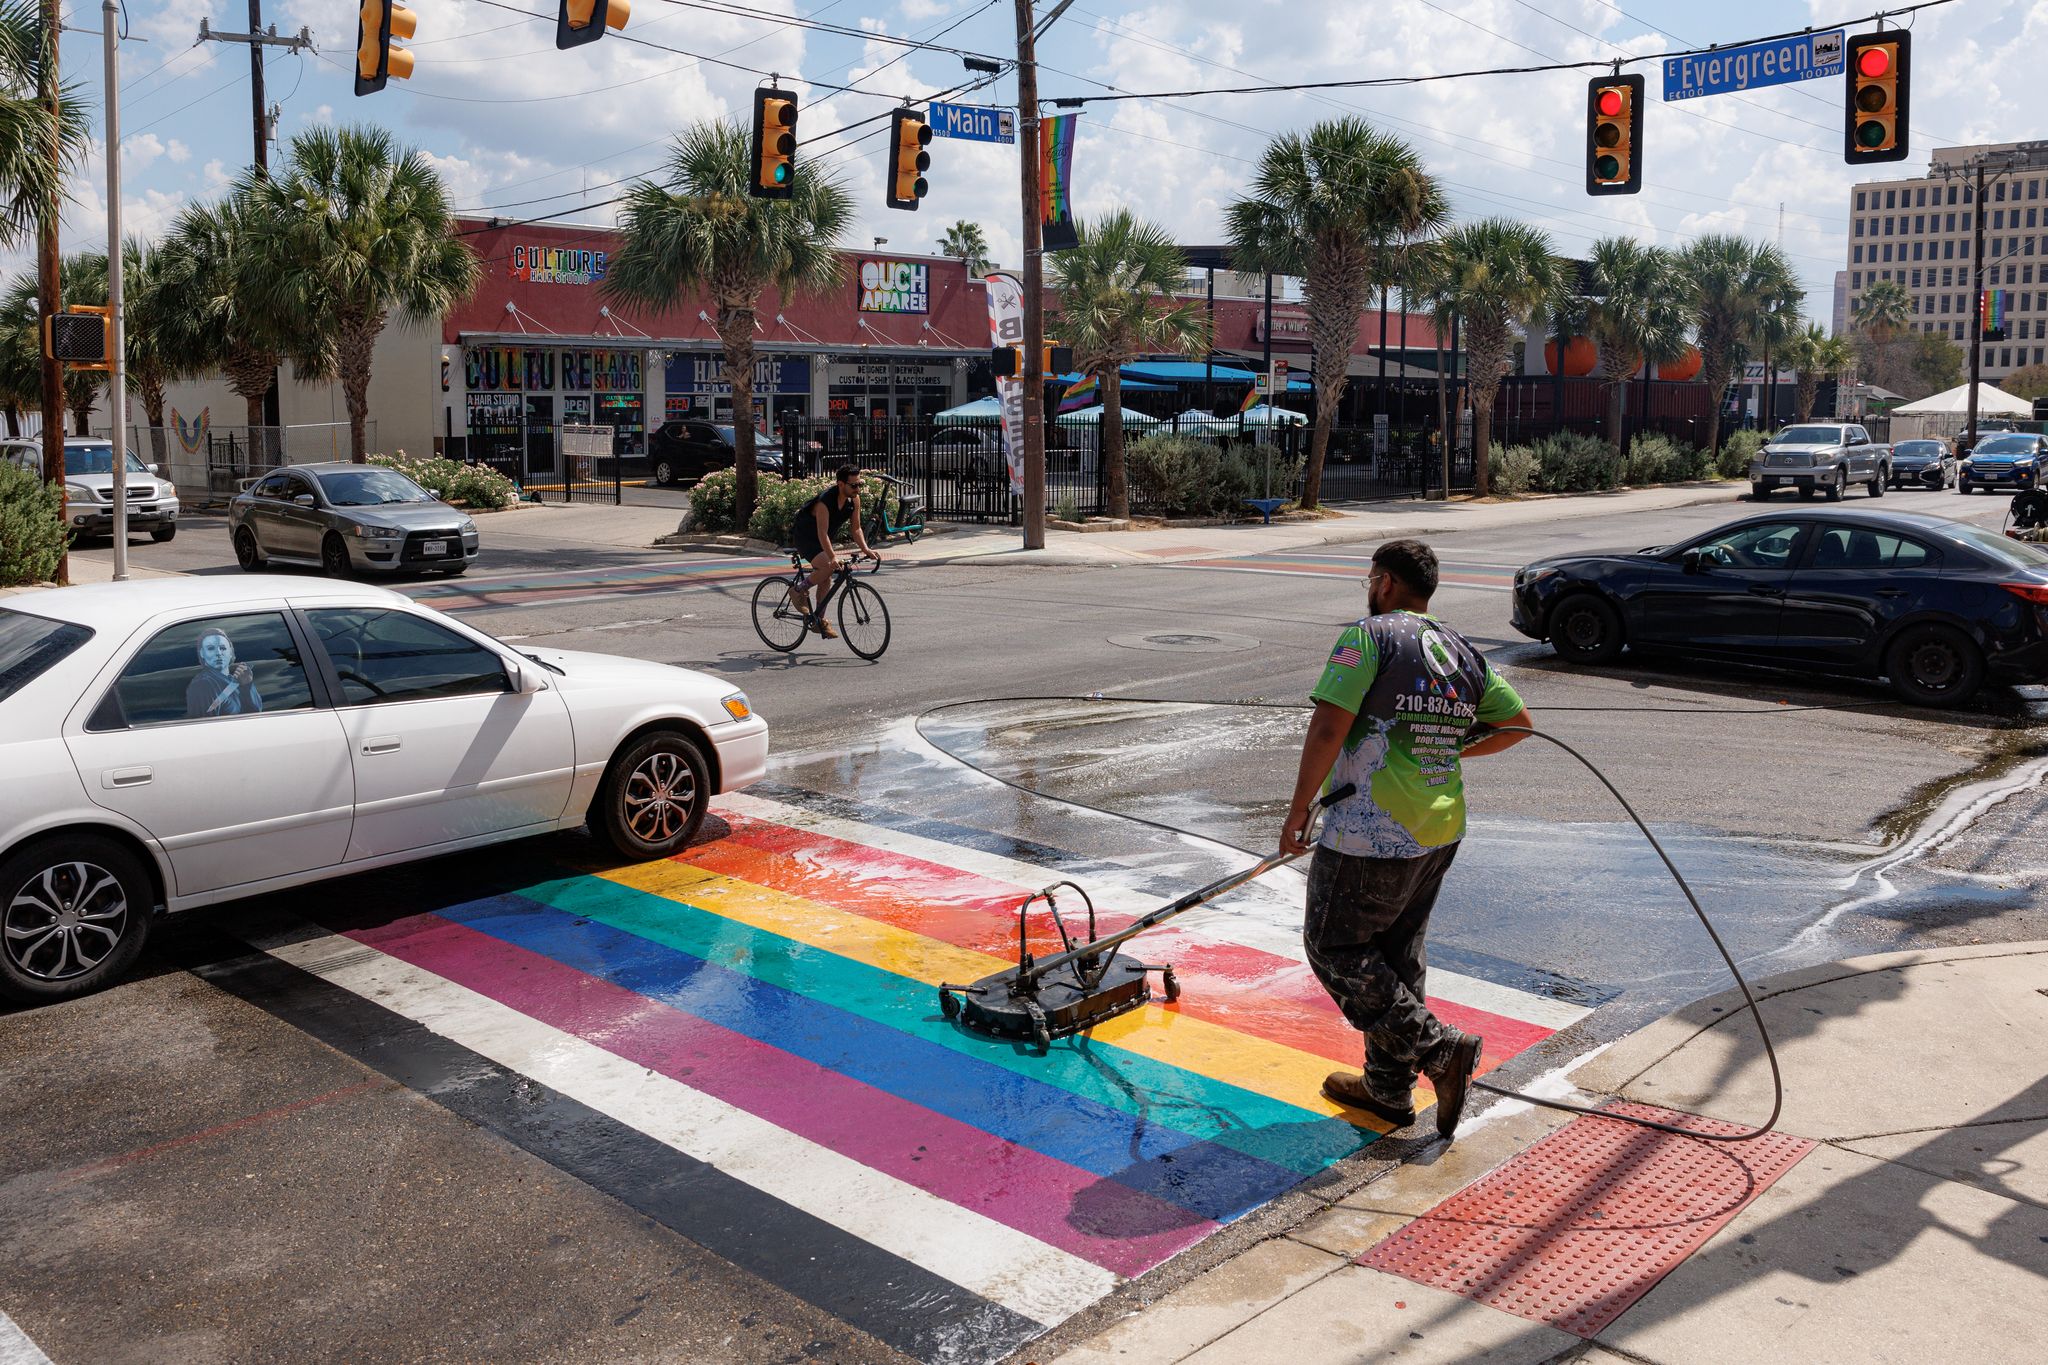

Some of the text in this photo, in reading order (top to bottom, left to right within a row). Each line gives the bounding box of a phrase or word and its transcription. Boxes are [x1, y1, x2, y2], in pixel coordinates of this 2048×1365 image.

[1668, 42, 1808, 90] E Evergreen
[1799, 65, 1840, 80] 100 W
[1668, 87, 1704, 101] E 100
[937, 105, 992, 136] N Main
[514, 245, 605, 274] CULTURE
[530, 270, 590, 285] HAIR STUDIO
[862, 261, 926, 293] OUCH
[862, 290, 927, 311] APPAREL
[465, 350, 592, 389] CULTURE
[594, 353, 640, 373] HAIR
[594, 373, 640, 389] STUDIO
[839, 376, 865, 384] CUSTOM
[902, 376, 941, 385] ACCSSORIES
[474, 394, 492, 405] HAIR
[493, 394, 519, 405] STUDIO
[563, 399, 590, 411] OPEN
[1395, 711, 1439, 723] COMMERCIAL
[1409, 723, 1440, 734] PRESSURE
[1415, 735, 1434, 745] ROOF
[1411, 747, 1439, 755] WINDOW
